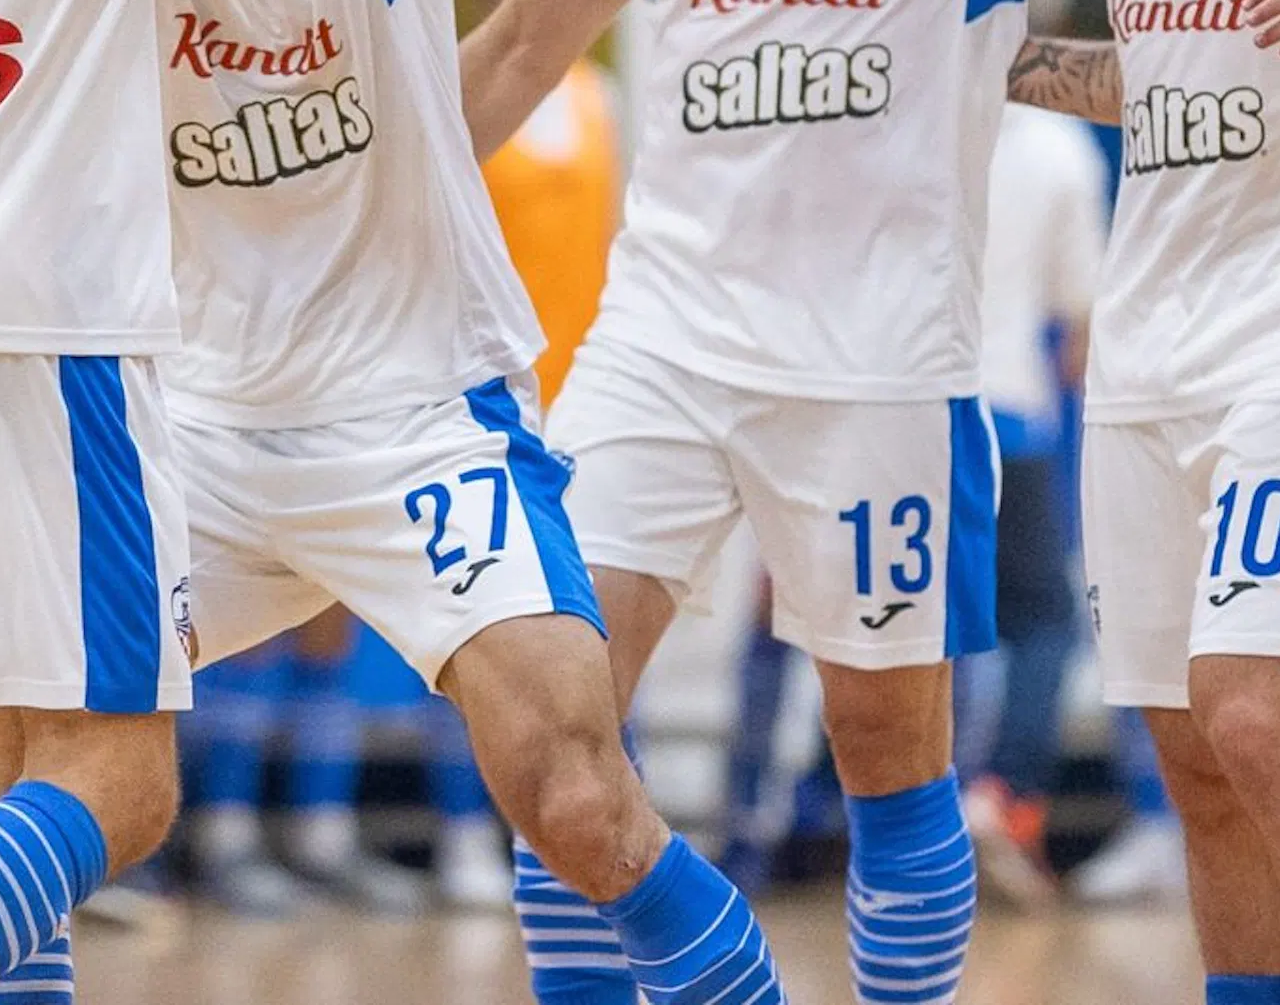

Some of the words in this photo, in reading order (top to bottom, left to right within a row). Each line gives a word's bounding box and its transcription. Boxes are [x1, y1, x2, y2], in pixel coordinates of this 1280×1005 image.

[170, 13, 343, 78] Kandt
[682, 40, 892, 133] saltas
[171, 76, 373, 187] saltas
[404, 468, 508, 576] 27
[839, 495, 932, 595] 13
